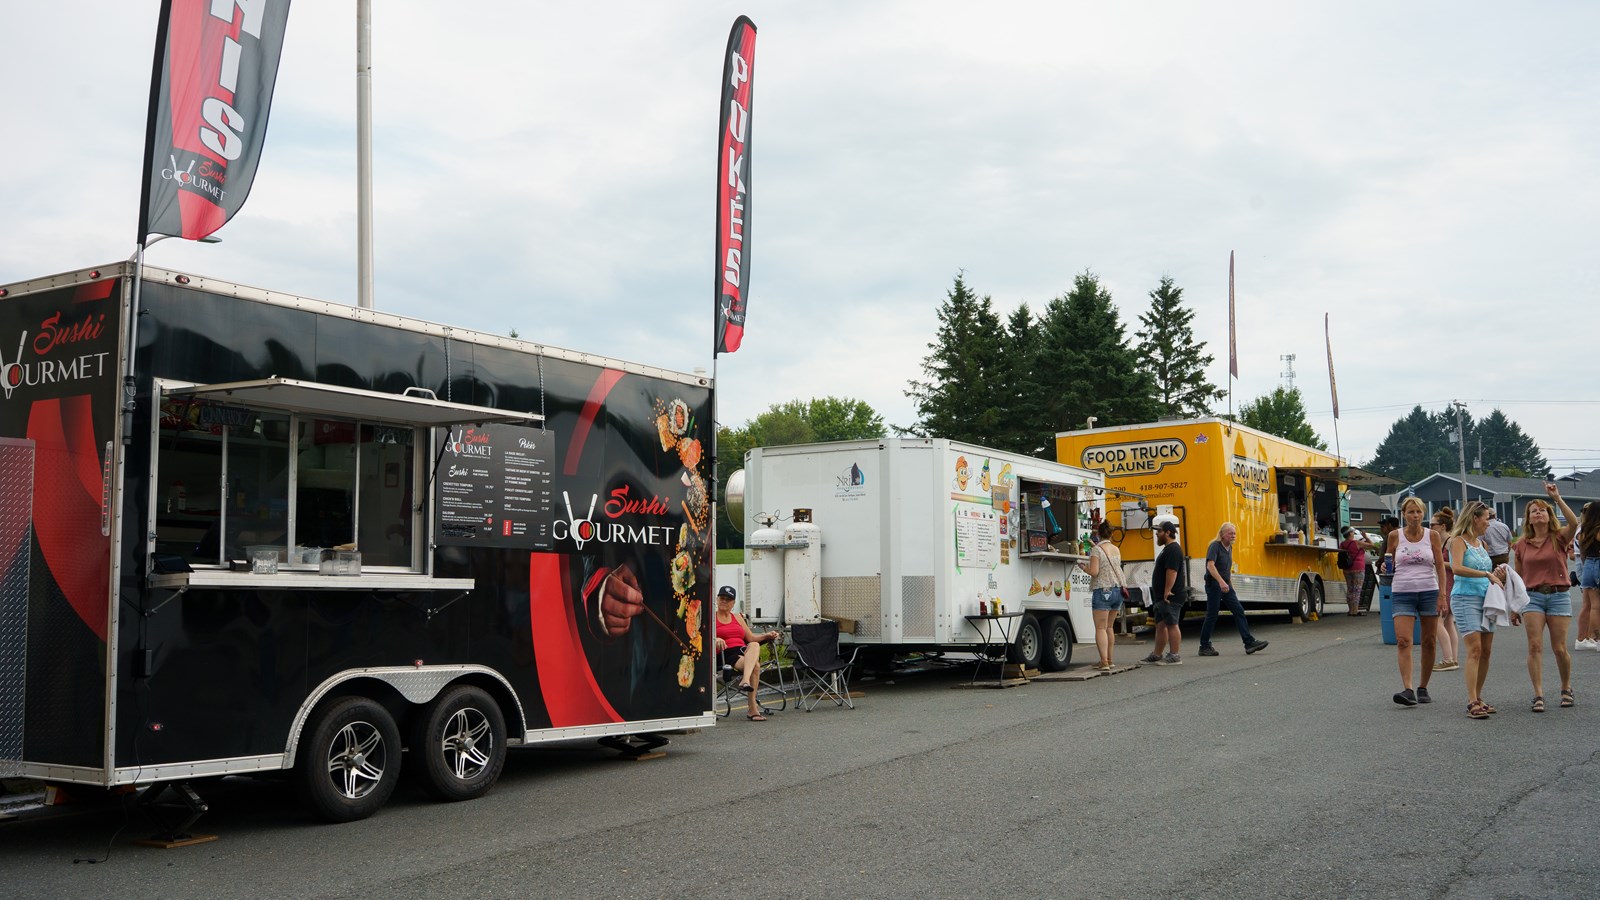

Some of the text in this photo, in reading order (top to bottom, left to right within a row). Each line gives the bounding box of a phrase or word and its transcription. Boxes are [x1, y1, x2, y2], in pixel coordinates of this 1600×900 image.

[161, 168, 227, 201] GOURMET
[198, 160, 228, 186] Sushi
[33, 311, 105, 355] Sushi
[0, 352, 110, 389] OURMET
[464, 428, 490, 445] Sushi
[445, 441, 493, 456] GOURMET
[1086, 444, 1179, 465] FOOD TRUCK
[448, 464, 469, 477] Sushi
[1109, 460, 1155, 473] JAUNE
[1139, 481, 1188, 492] 418-907-5827
[604, 484, 670, 519] Sushi
[553, 519, 675, 546] GOURMET
